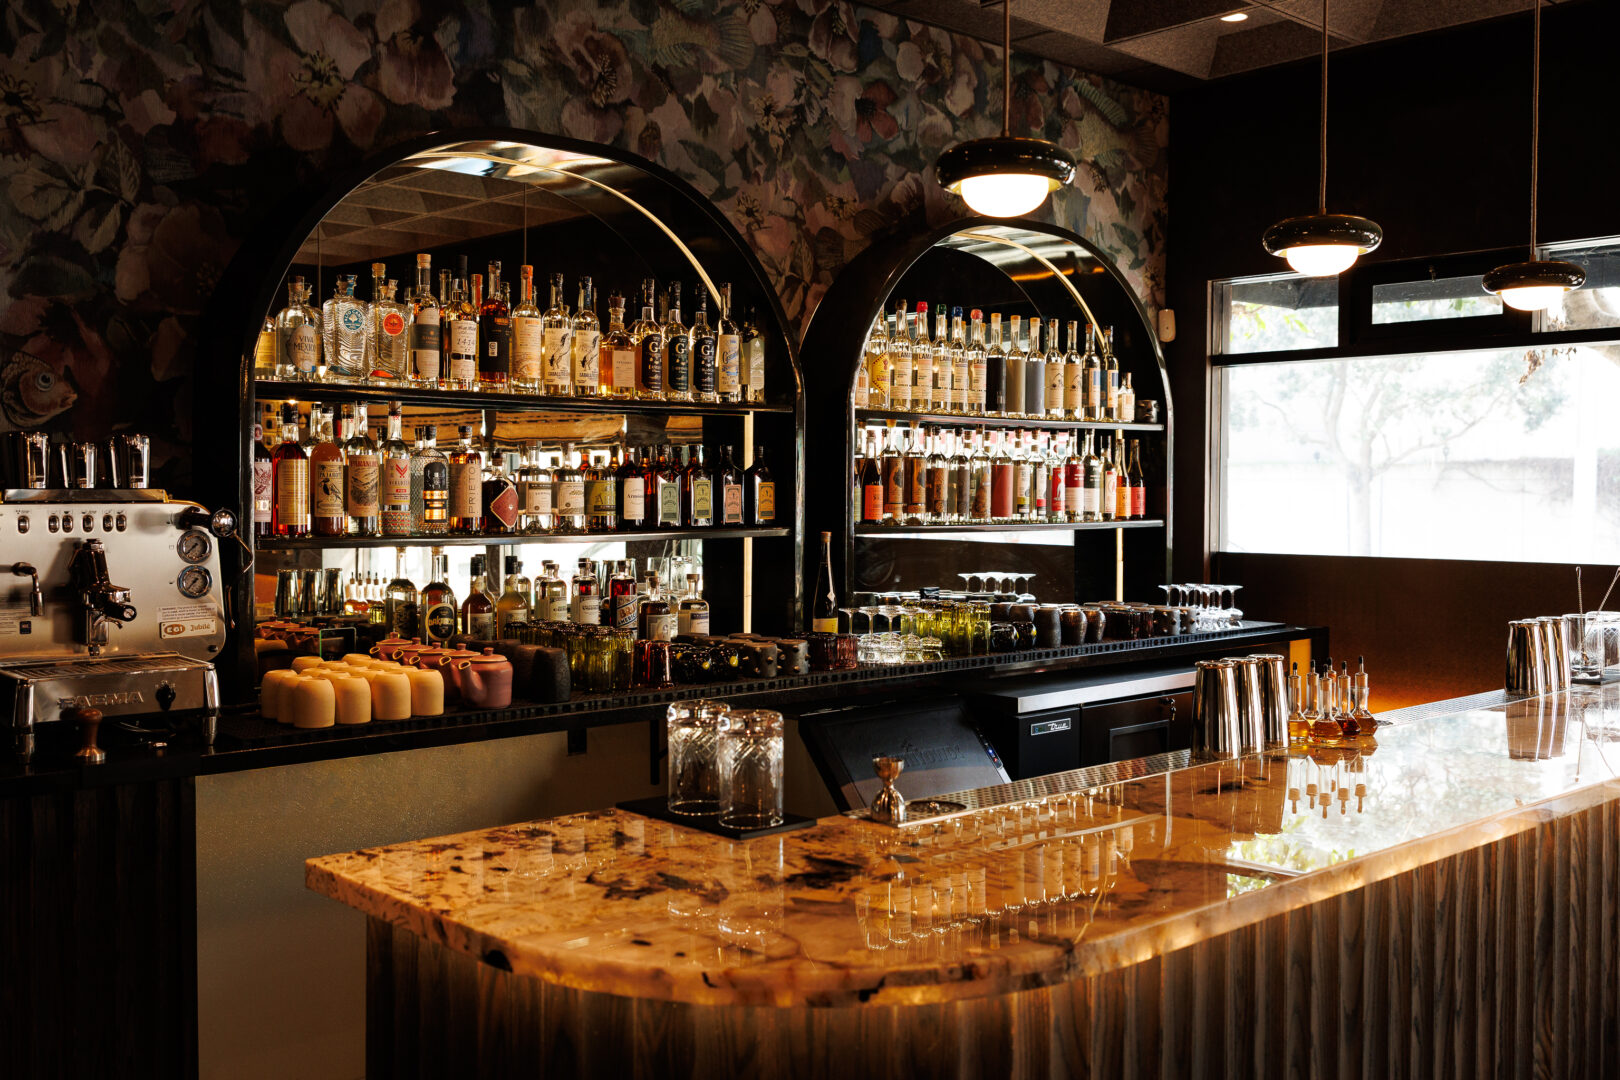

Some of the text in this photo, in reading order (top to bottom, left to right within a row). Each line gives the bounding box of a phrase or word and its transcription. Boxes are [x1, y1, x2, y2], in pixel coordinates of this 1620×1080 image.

[299, 335, 314, 344] VIVA
[468, 466, 477, 515] PRIETO
[190, 623, 211, 632] Jubilé
[1047, 722, 1069, 731] True
